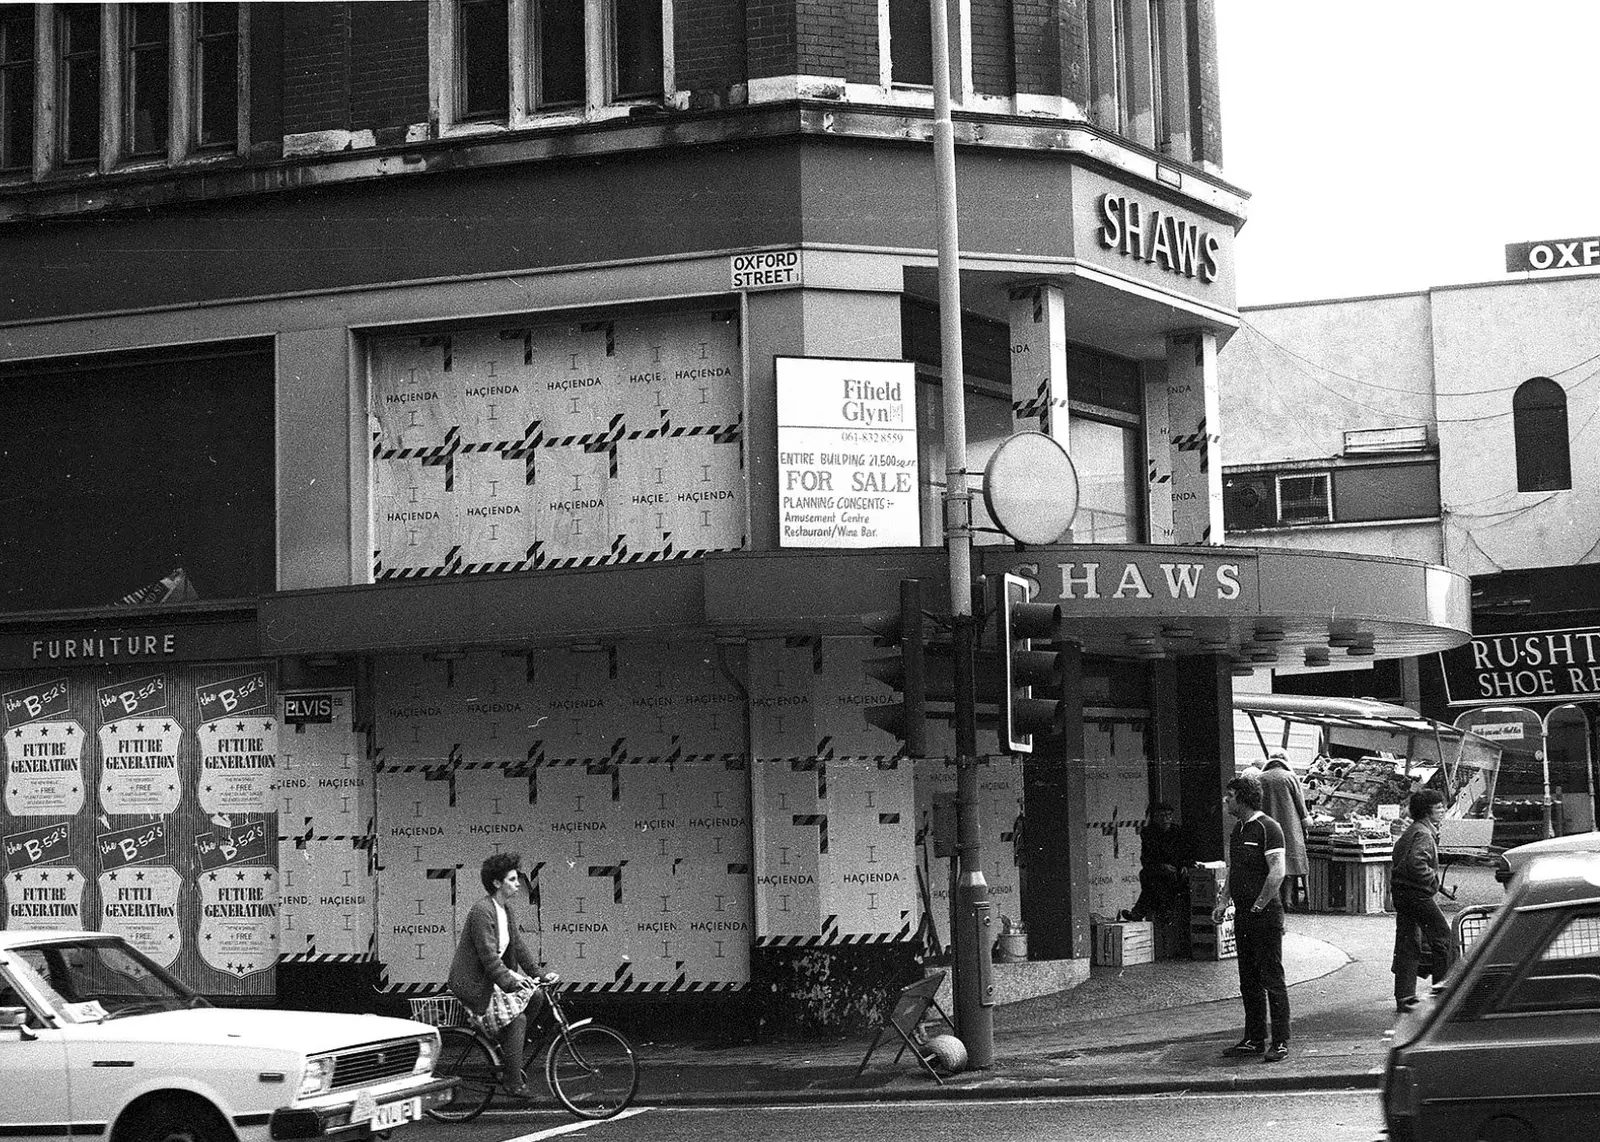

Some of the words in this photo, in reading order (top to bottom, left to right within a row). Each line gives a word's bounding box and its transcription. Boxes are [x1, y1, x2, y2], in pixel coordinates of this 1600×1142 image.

[1099, 192, 1219, 283] SHAWS
[734, 252, 797, 270] OXFORD
[1529, 241, 1600, 269] OXF
[734, 268, 793, 286] STREET
[386, 391, 439, 404] HAÇIENDA
[466, 385, 519, 397] HAÇIENDA
[547, 377, 602, 391] HAÇIENDA
[675, 367, 731, 380] HAÇIENDA
[843, 379, 901, 401] Fifield
[842, 401, 889, 426] Glyn
[780, 452, 814, 466] ENTIRE
[786, 470, 834, 492] FOR
[851, 471, 912, 493] SALE
[387, 511, 440, 523] HAÇIENDA
[467, 505, 521, 517] HAÇIENDA
[550, 499, 605, 512] HAÇIENDA
[677, 490, 734, 503] HAÇIENDA
[783, 496, 834, 510] PLANNING
[784, 511, 836, 523] Amusement
[841, 511, 870, 523] Centre
[1011, 562, 1241, 600] SHAWS
[32, 634, 175, 659] FURNITURE
[1478, 670, 1556, 697] SHOE
[285, 700, 331, 716] ELVIS
[23, 742, 67, 757] FUTURE
[118, 739, 163, 753] FUTURE
[218, 738, 264, 752] FUTURE
[11, 758, 78, 773] GENERATION
[106, 755, 175, 770] GENERATION
[204, 754, 276, 769] GENERATION
[391, 826, 444, 838] HAÇIENDA
[470, 823, 524, 835] HAÇIENDA
[551, 821, 607, 833] HAÇIENDA
[688, 817, 745, 829] HAÇIENDA
[757, 875, 814, 887] HAÇIENDA
[843, 872, 900, 884] HAÇIENDA
[23, 888, 67, 901] FUTURE
[218, 888, 264, 901] FUTURE
[11, 903, 78, 917] GENERATION
[204, 903, 276, 917] GENERATION
[393, 925, 447, 936] HAÇIENDA
[553, 923, 609, 934] HAÇIENDA
[690, 920, 748, 933] HAÇIENDA
